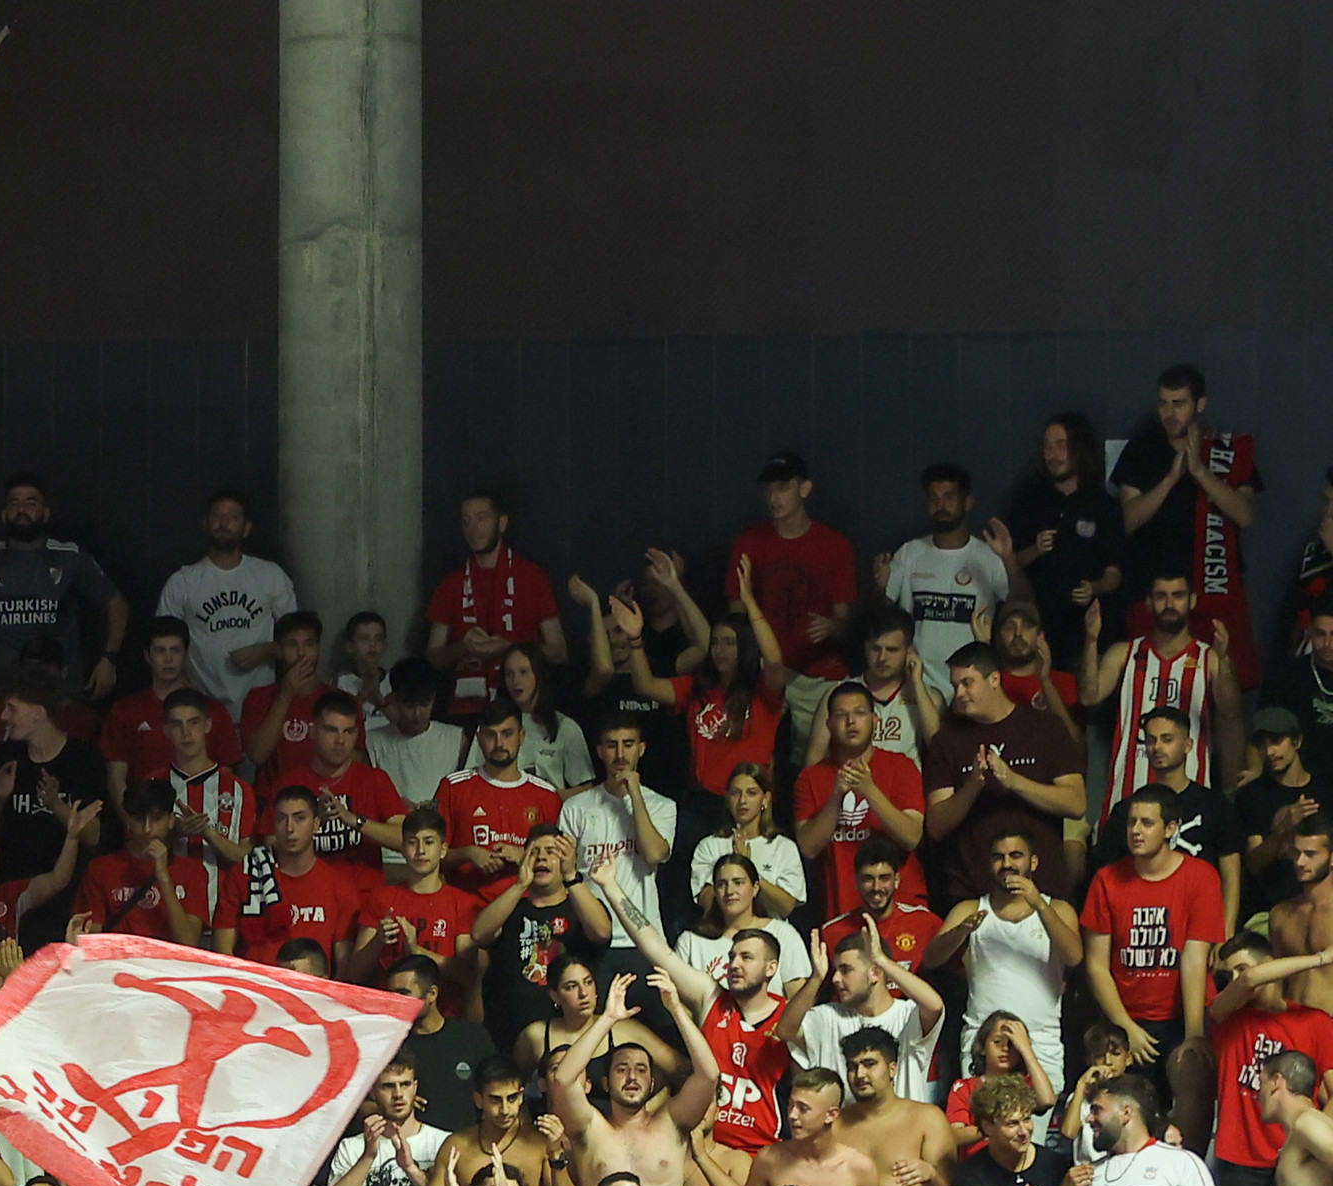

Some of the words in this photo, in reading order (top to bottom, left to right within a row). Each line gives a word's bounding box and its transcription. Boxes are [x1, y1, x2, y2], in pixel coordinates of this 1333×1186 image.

[196, 590, 263, 624] LONSDALE
[0, 612, 57, 626] AIRLINES
[209, 618, 250, 633] LONDON
[1133, 906, 1166, 926] אהבה
